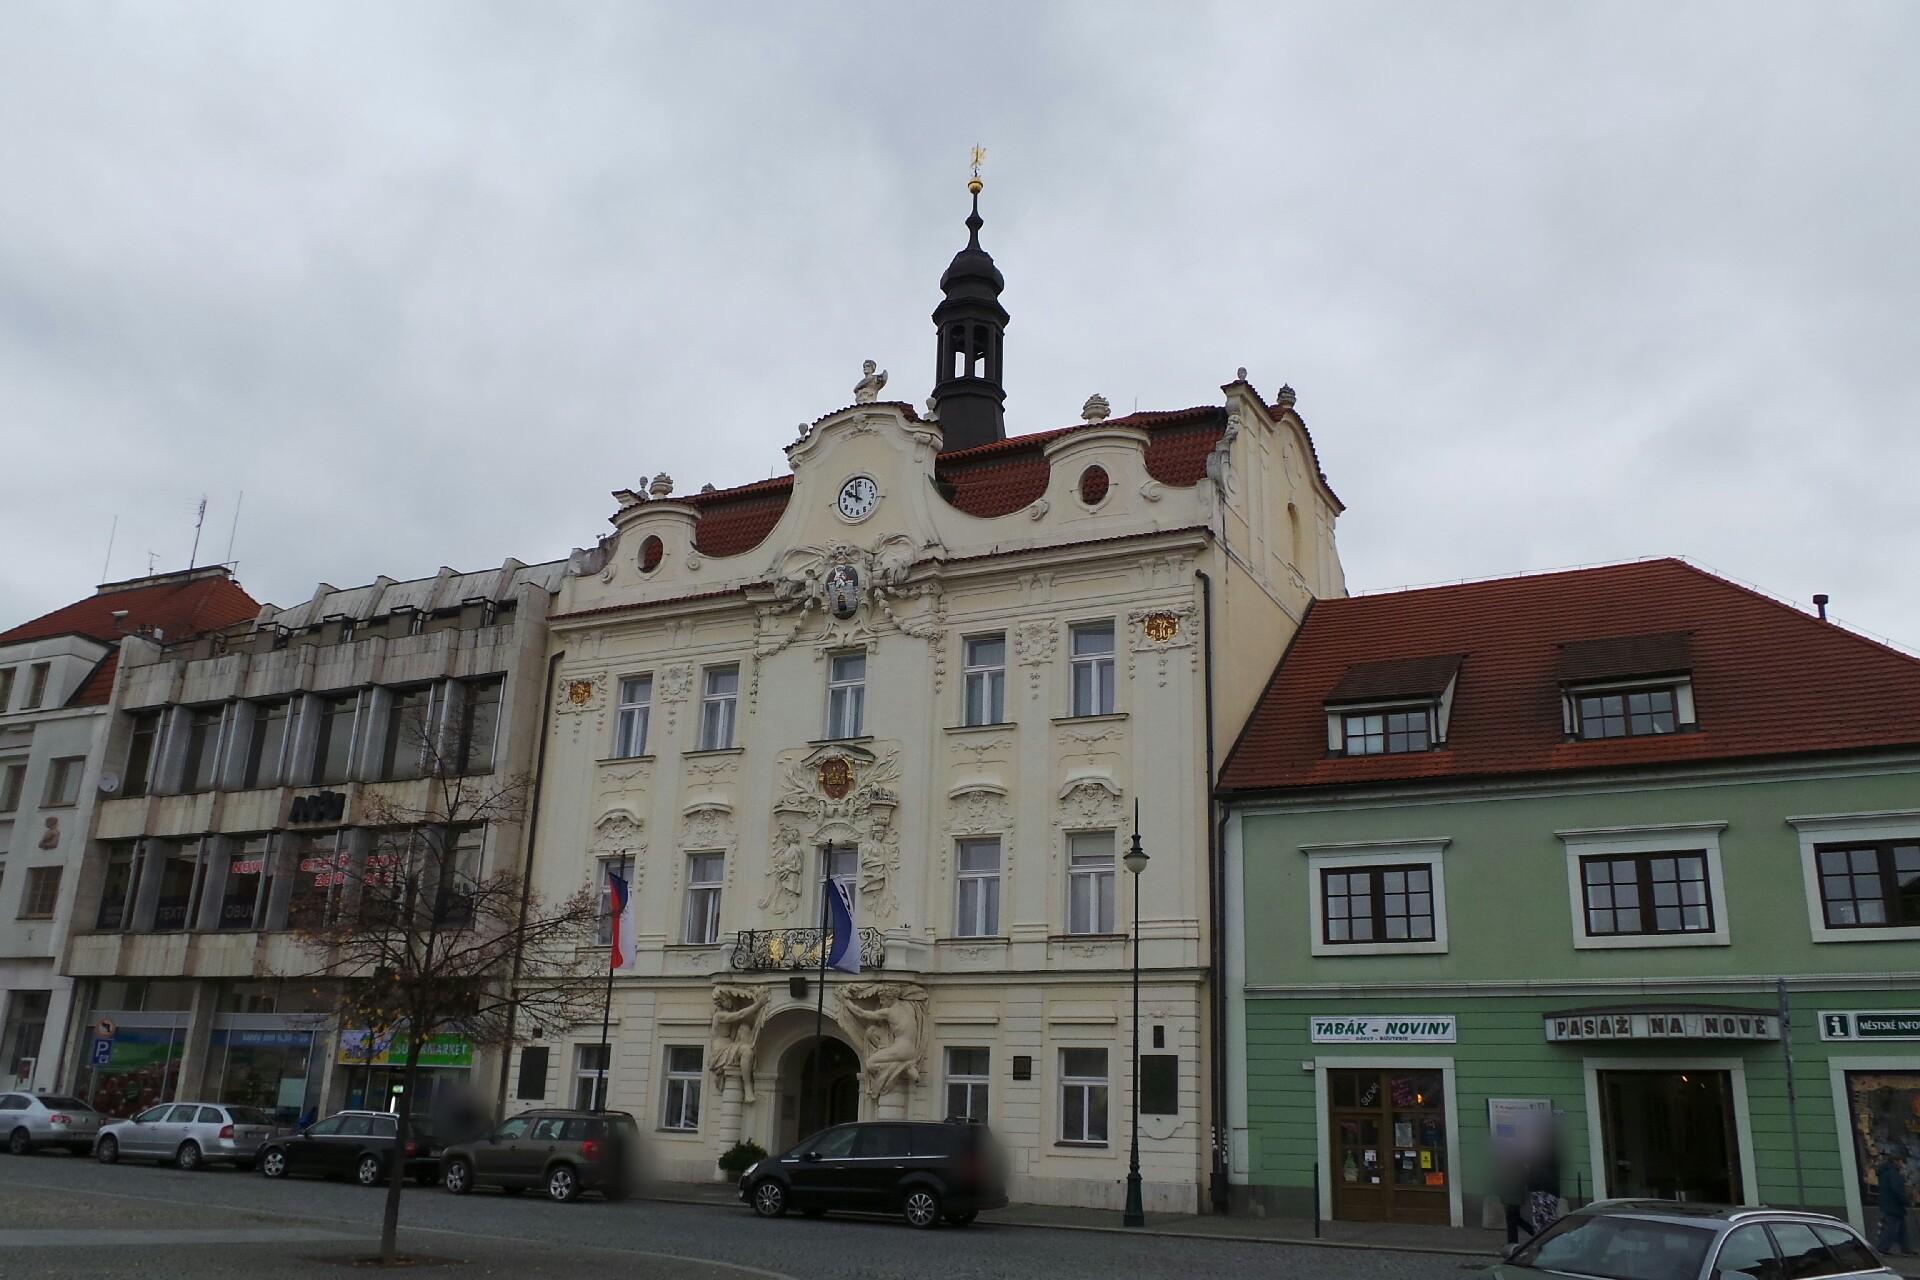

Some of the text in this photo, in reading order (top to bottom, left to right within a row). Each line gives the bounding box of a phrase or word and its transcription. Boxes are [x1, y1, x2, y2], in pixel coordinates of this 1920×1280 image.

[1315, 1020, 1368, 1035] TABÁK
[1385, 1022, 1451, 1035] NOVINY
[1556, 1015, 1768, 1036] PASÁŽ NA NOVÉ
[1860, 1020, 1897, 1030] MĚSTSKÉ
